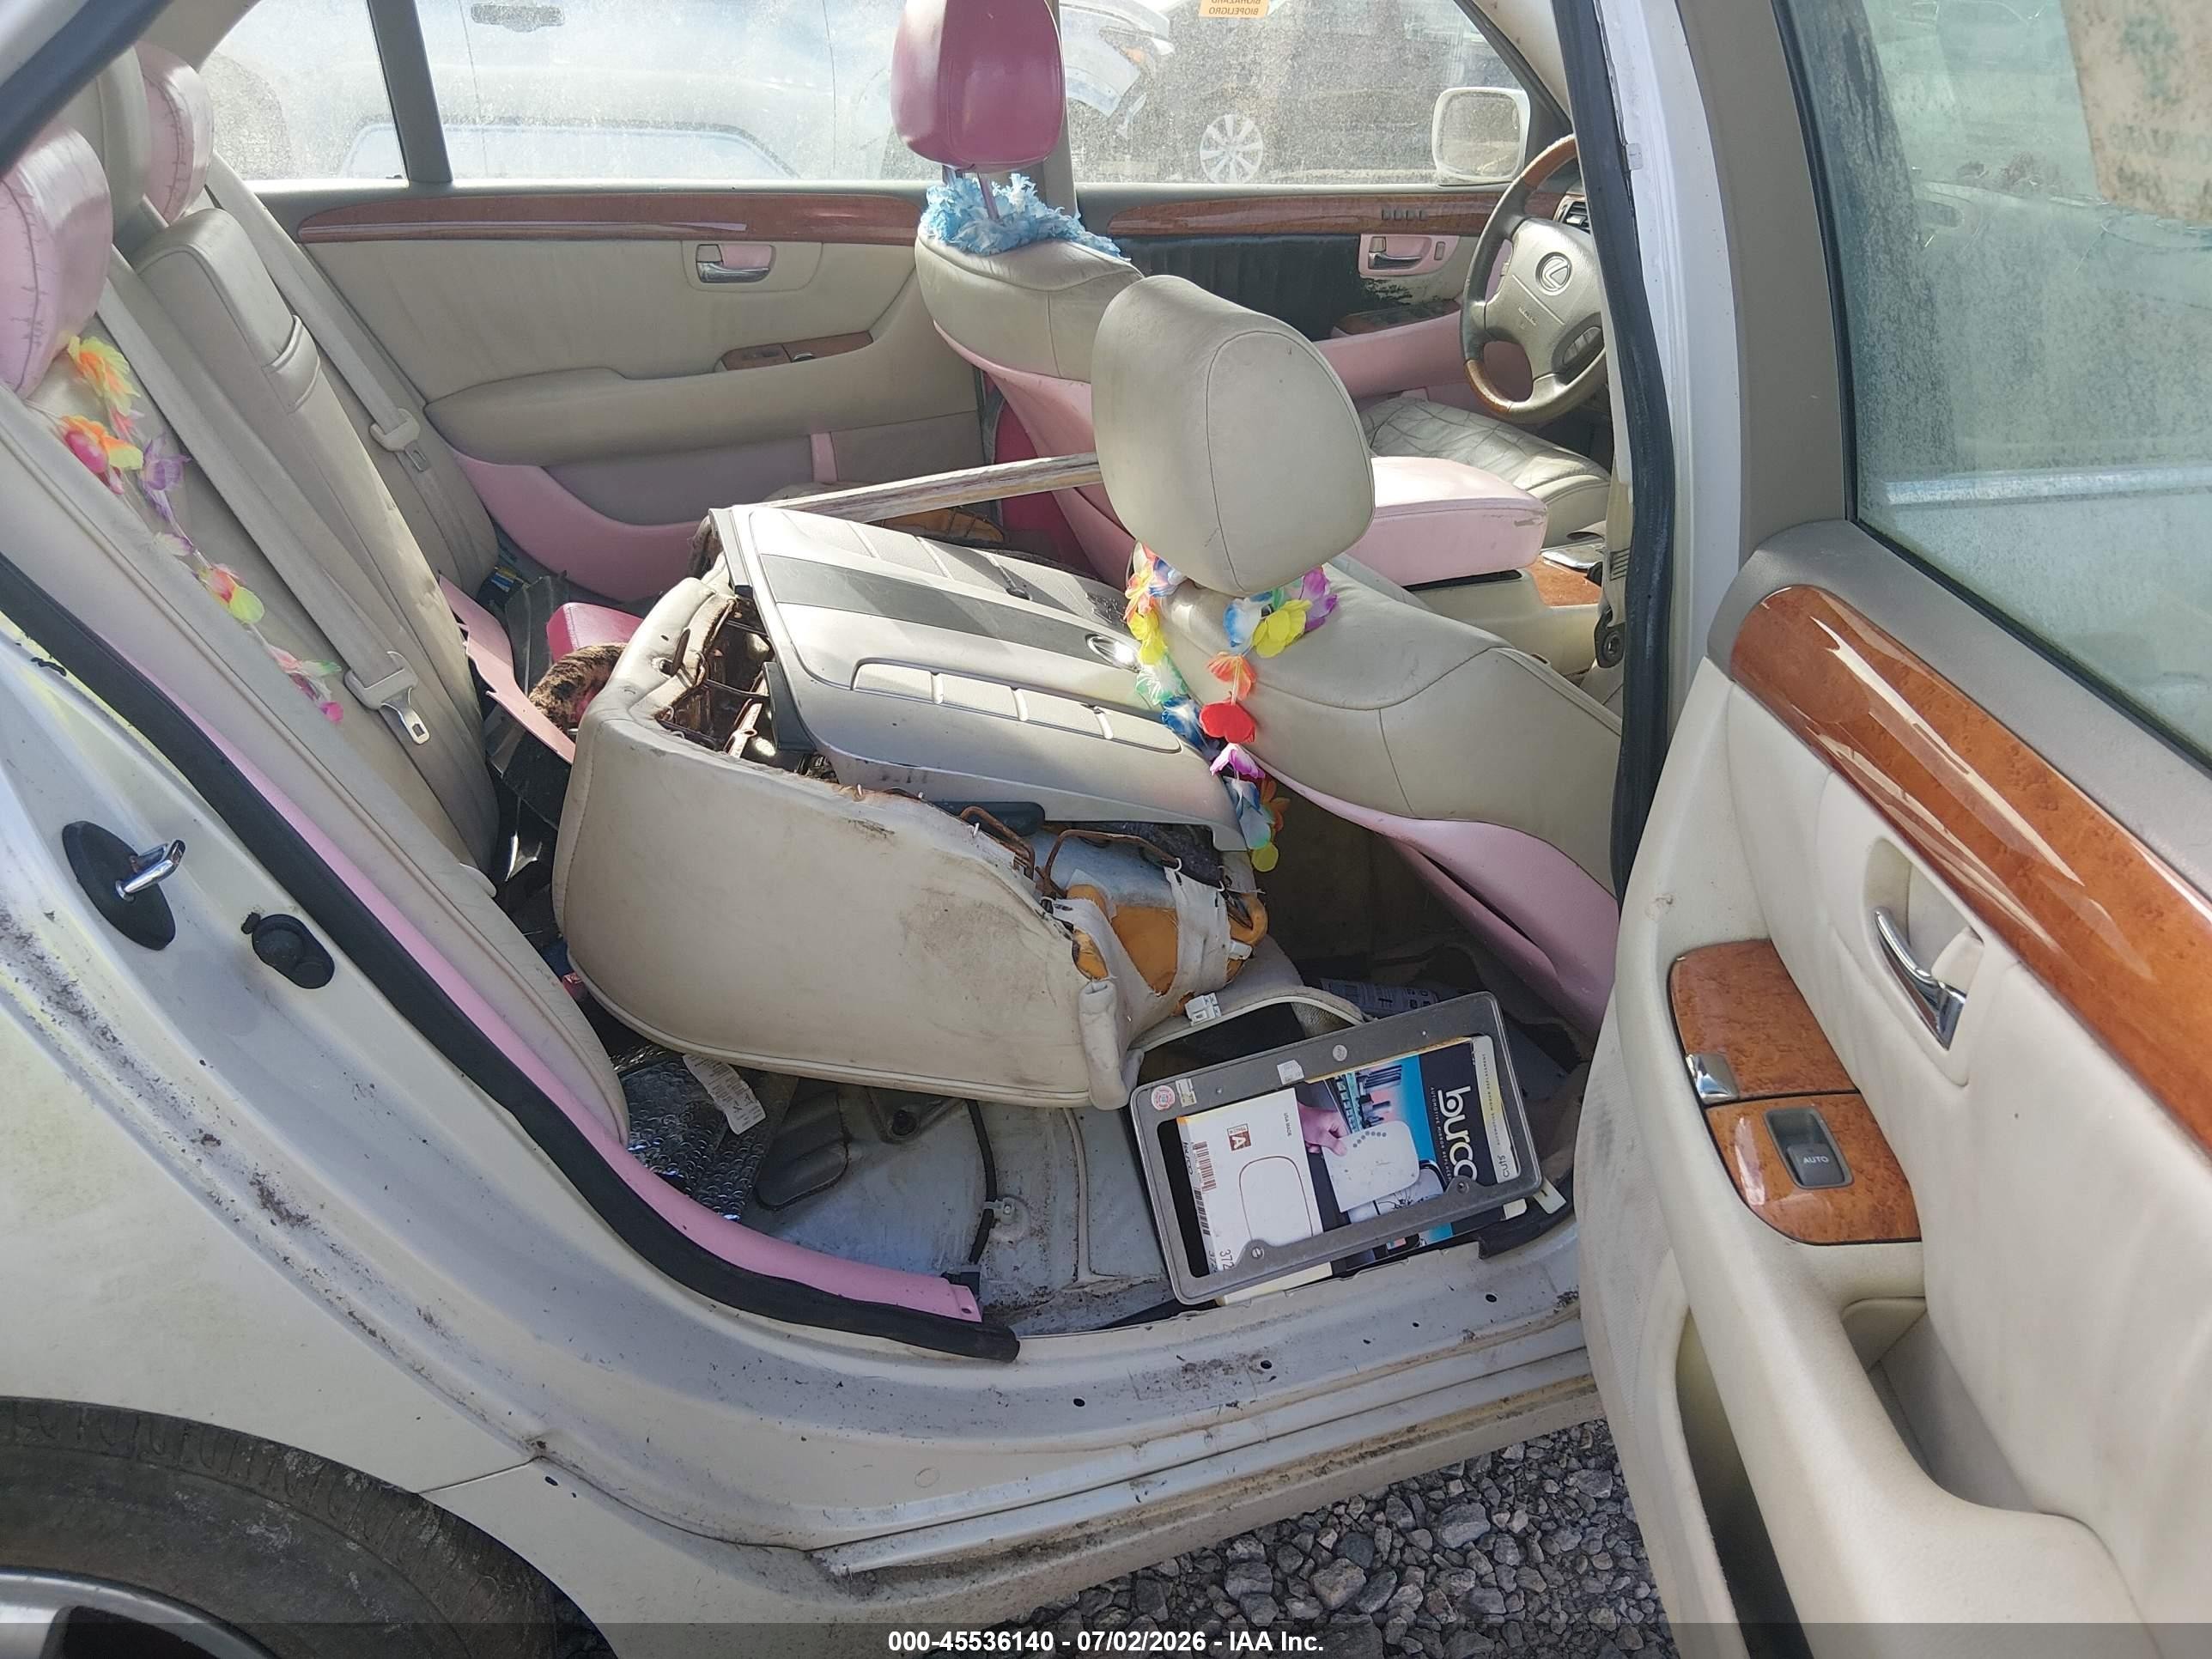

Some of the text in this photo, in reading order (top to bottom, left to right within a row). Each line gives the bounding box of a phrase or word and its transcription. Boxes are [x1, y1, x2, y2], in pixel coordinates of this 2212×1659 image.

[1430, 1086, 1440, 1124] AUTOMOTIVE
[1437, 1126, 1445, 1149] MIRROR
[1437, 1085, 1477, 1181] burco
